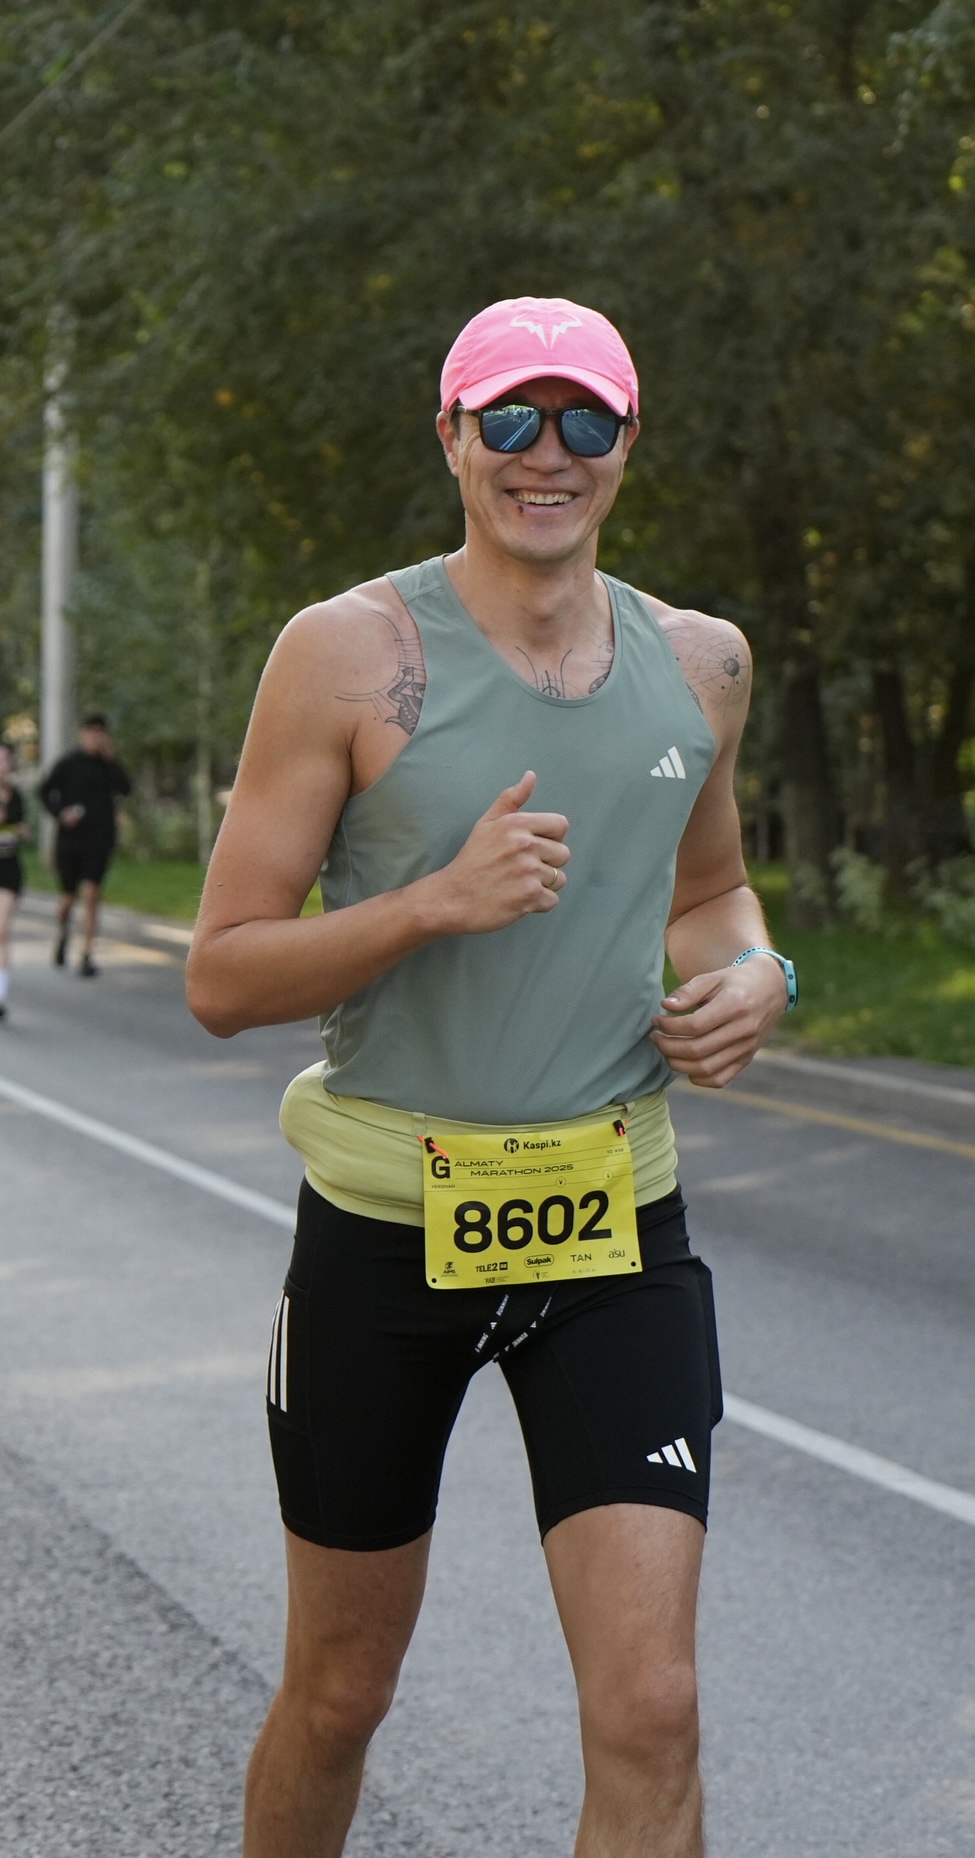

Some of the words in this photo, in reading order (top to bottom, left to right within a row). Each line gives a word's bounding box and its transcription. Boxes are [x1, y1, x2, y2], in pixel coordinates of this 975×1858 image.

[523, 1139, 562, 1151] Kaspi.kz
[431, 1155, 451, 1180] G
[470, 1168, 541, 1177] MARATHON
[544, 1163, 574, 1173] 2025
[453, 1190, 613, 1253] 8602
[526, 1256, 552, 1265] Sulpak
[570, 1253, 592, 1262] TAN
[475, 1262, 498, 1273] TELE2
